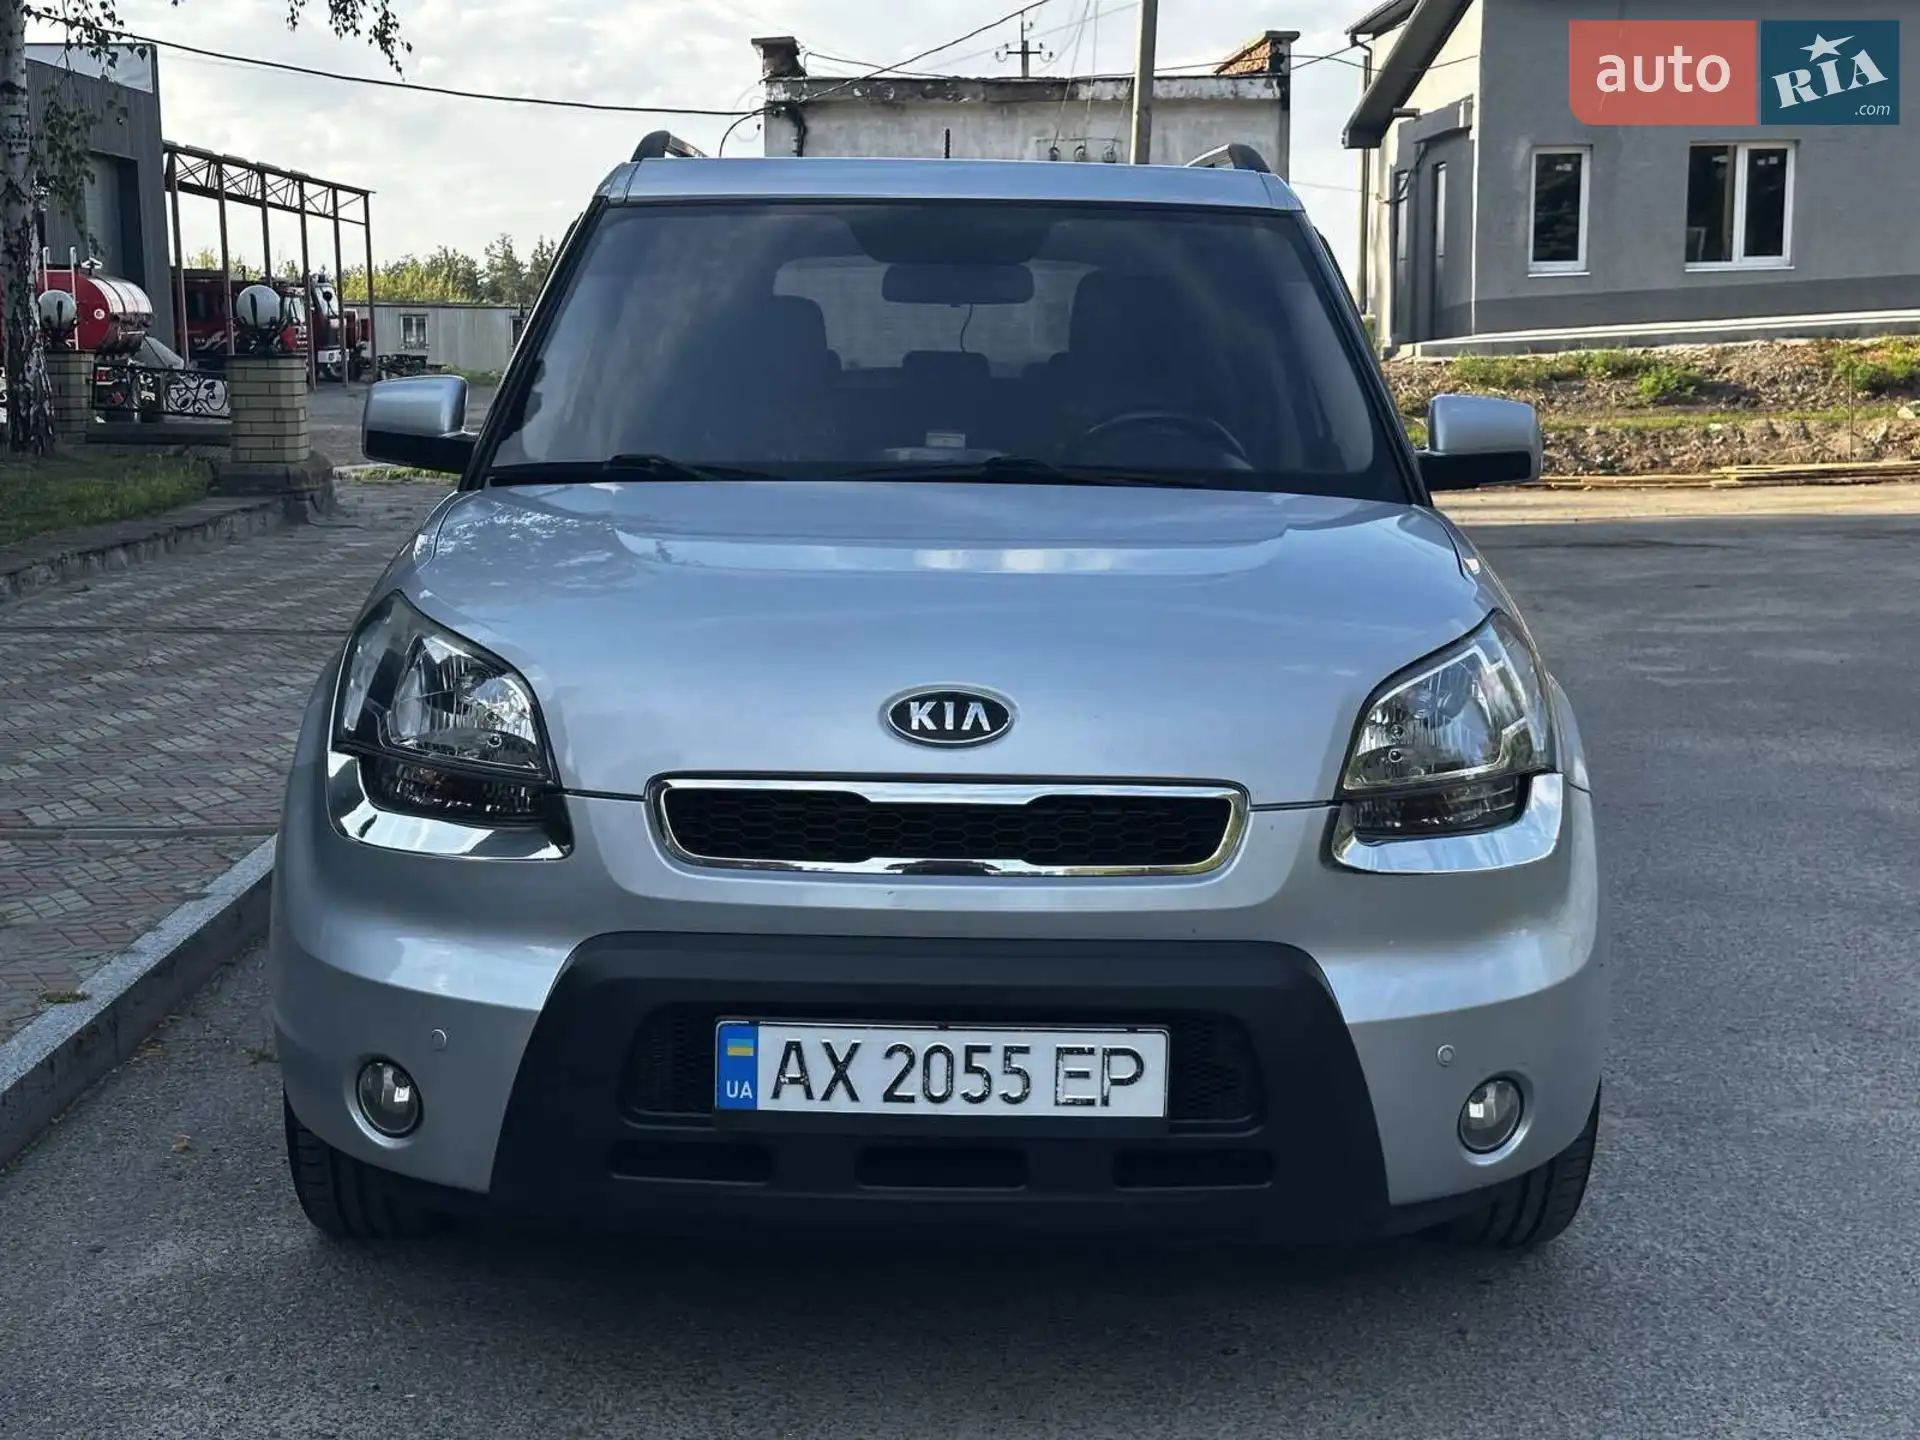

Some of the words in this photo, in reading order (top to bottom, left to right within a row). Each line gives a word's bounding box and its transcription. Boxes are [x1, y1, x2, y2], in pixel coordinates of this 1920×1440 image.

[909, 701, 991, 731] KIA
[771, 1039, 862, 1102] AX
[882, 1042, 1032, 1104] 2055
[1055, 1045, 1146, 1107] EP
[726, 1080, 753, 1099] UA
